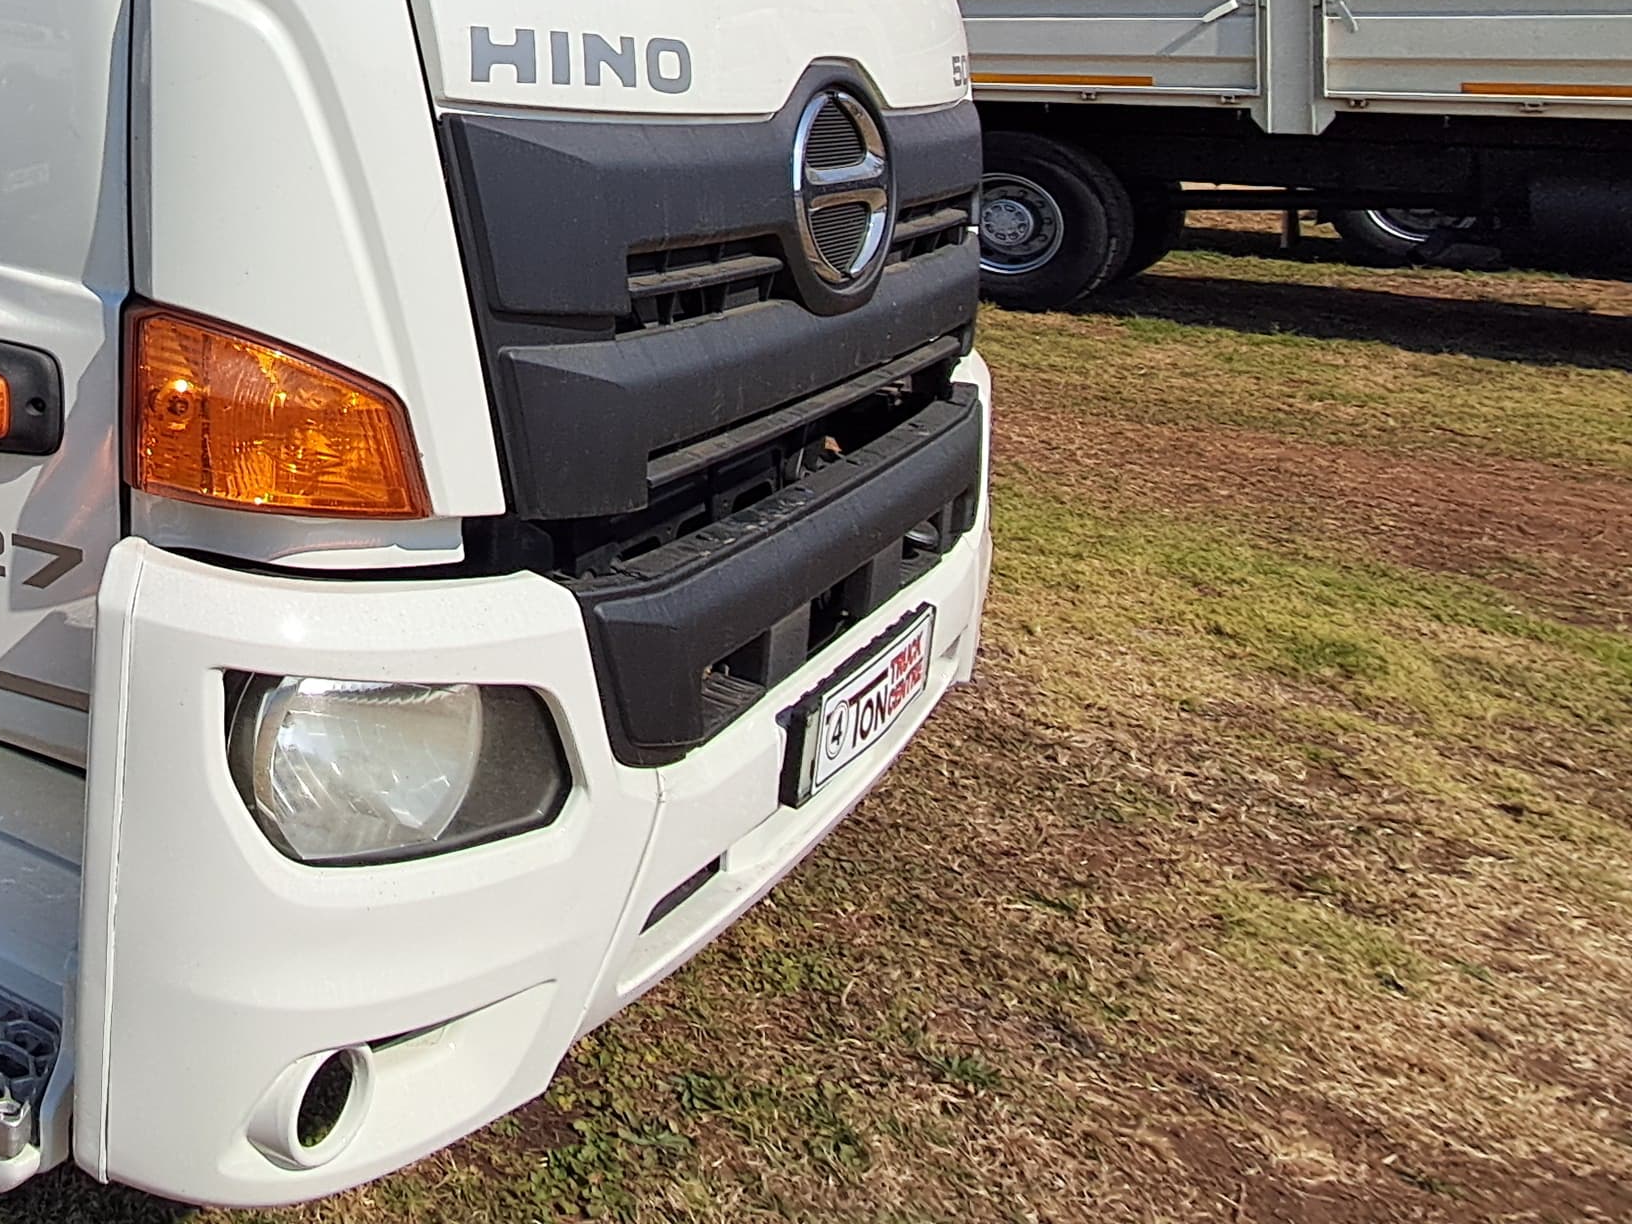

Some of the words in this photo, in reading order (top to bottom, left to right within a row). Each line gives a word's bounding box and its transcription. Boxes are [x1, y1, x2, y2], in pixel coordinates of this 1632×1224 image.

[469, 25, 693, 95] HINO
[887, 657, 924, 716] CENTRE
[889, 630, 924, 685] TRUCK
